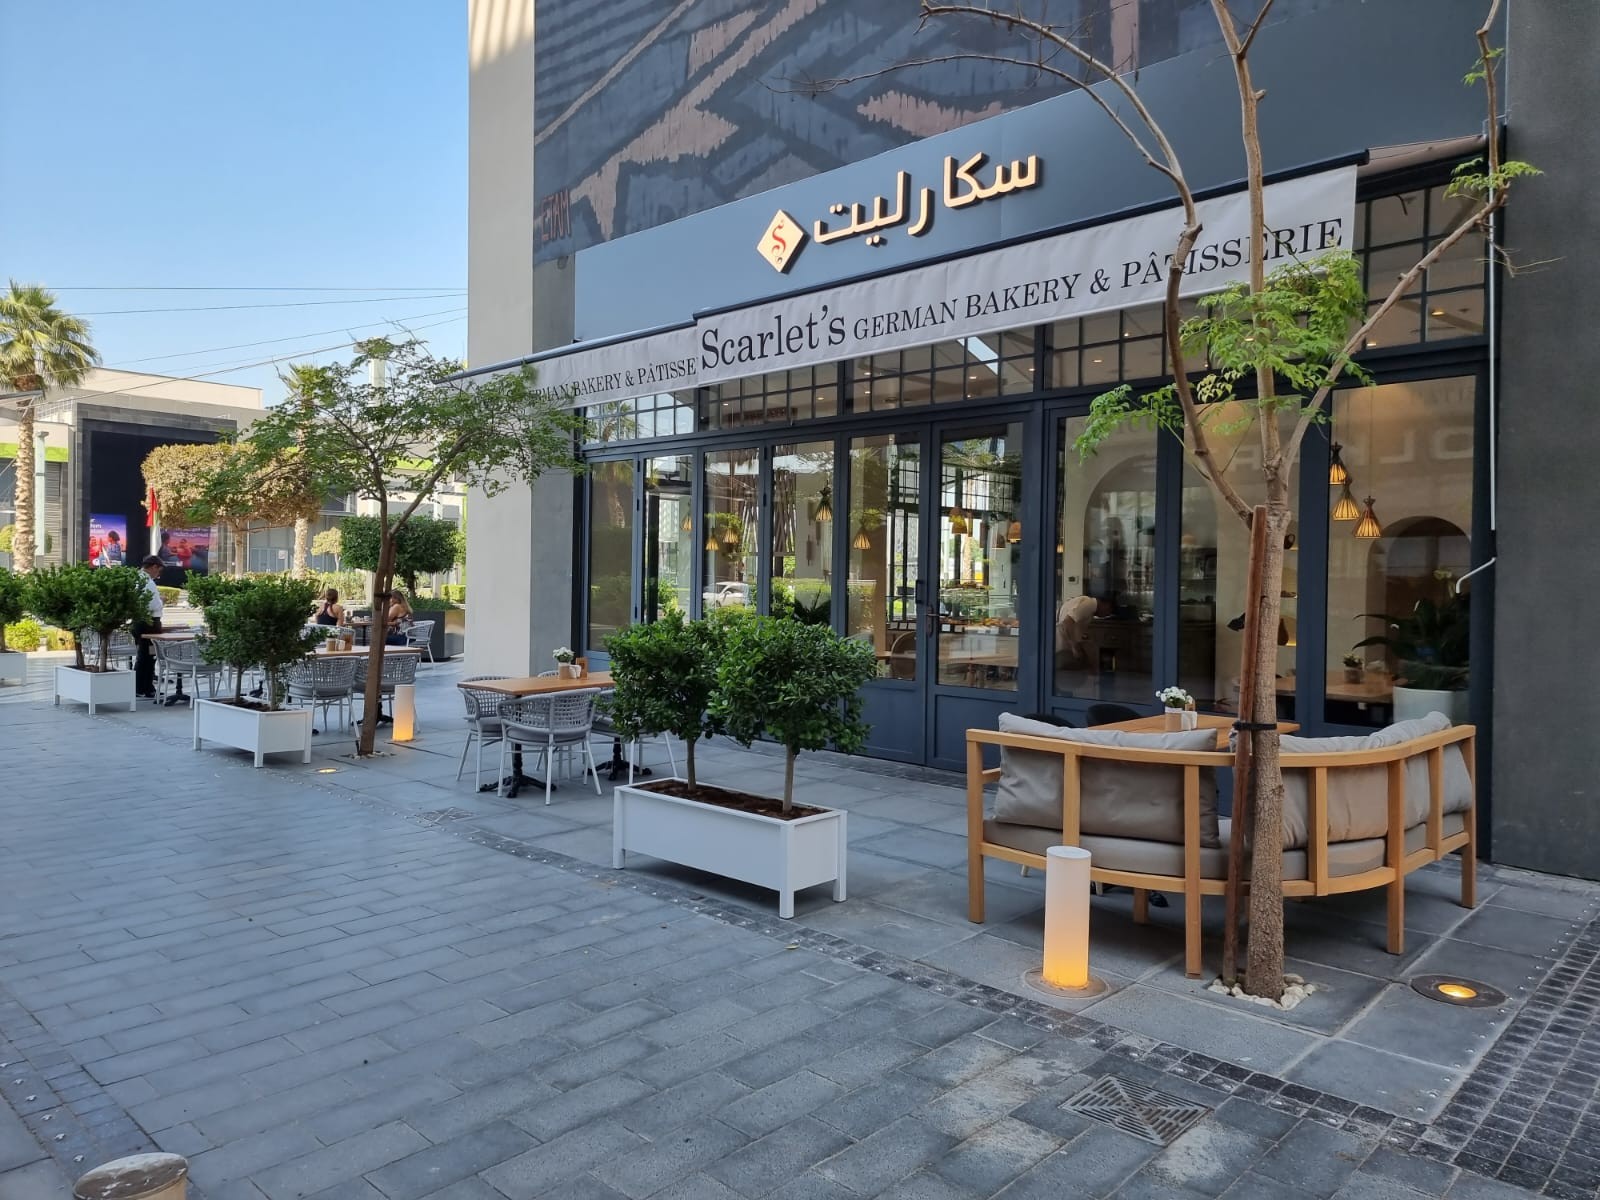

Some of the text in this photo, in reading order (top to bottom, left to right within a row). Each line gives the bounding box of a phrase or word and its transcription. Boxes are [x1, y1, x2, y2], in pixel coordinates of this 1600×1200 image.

[701, 304, 846, 370] Scarlet's
[853, 298, 959, 341] GERMAN
[965, 273, 1082, 319] BAKERY
[1089, 268, 1111, 294] &
[526, 357, 698, 404] ERMAN BAKERY & PÂTISSE
